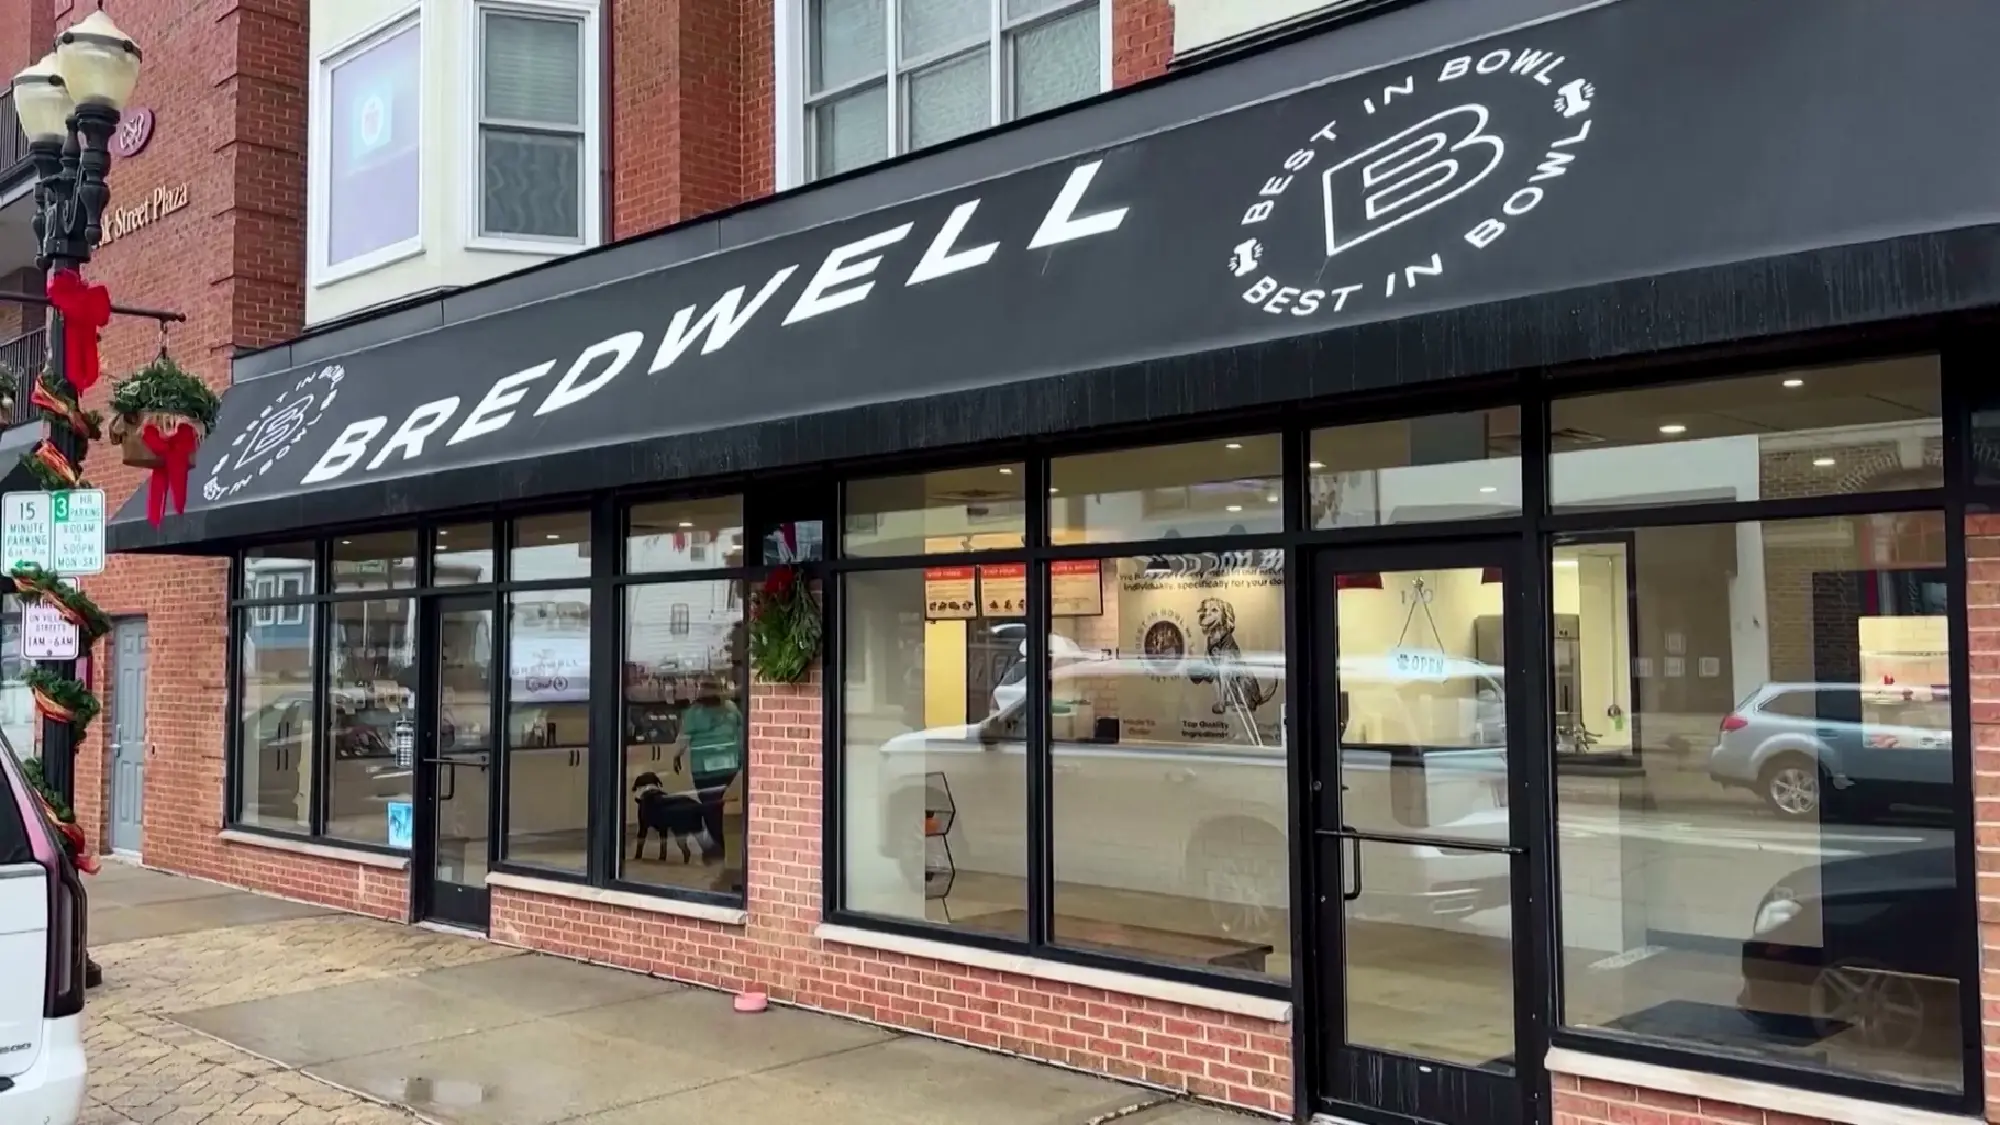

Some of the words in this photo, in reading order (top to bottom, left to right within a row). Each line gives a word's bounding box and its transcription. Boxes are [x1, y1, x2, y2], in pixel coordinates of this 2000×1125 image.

[1241, 121, 1337, 225] BEST
[1363, 76, 1414, 114] IN
[1438, 48, 1566, 86] BOWL
[114, 196, 149, 238] Street
[153, 182, 188, 220] Plaza
[1242, 275, 1364, 316] BEST
[1385, 253, 1443, 298] IN
[1464, 119, 1592, 249] BOWL
[300, 159, 1130, 485] BREDWELL
[20, 501, 36, 521] 15
[56, 497, 68, 517] 3
[70, 509, 100, 517] PARKING
[10, 523, 44, 534] MINUTE
[7, 535, 47, 546] PARKING
[1411, 655, 1444, 674] OPEN
[1182, 720, 1198, 729] Top
[1199, 720, 1230, 730] Quality
